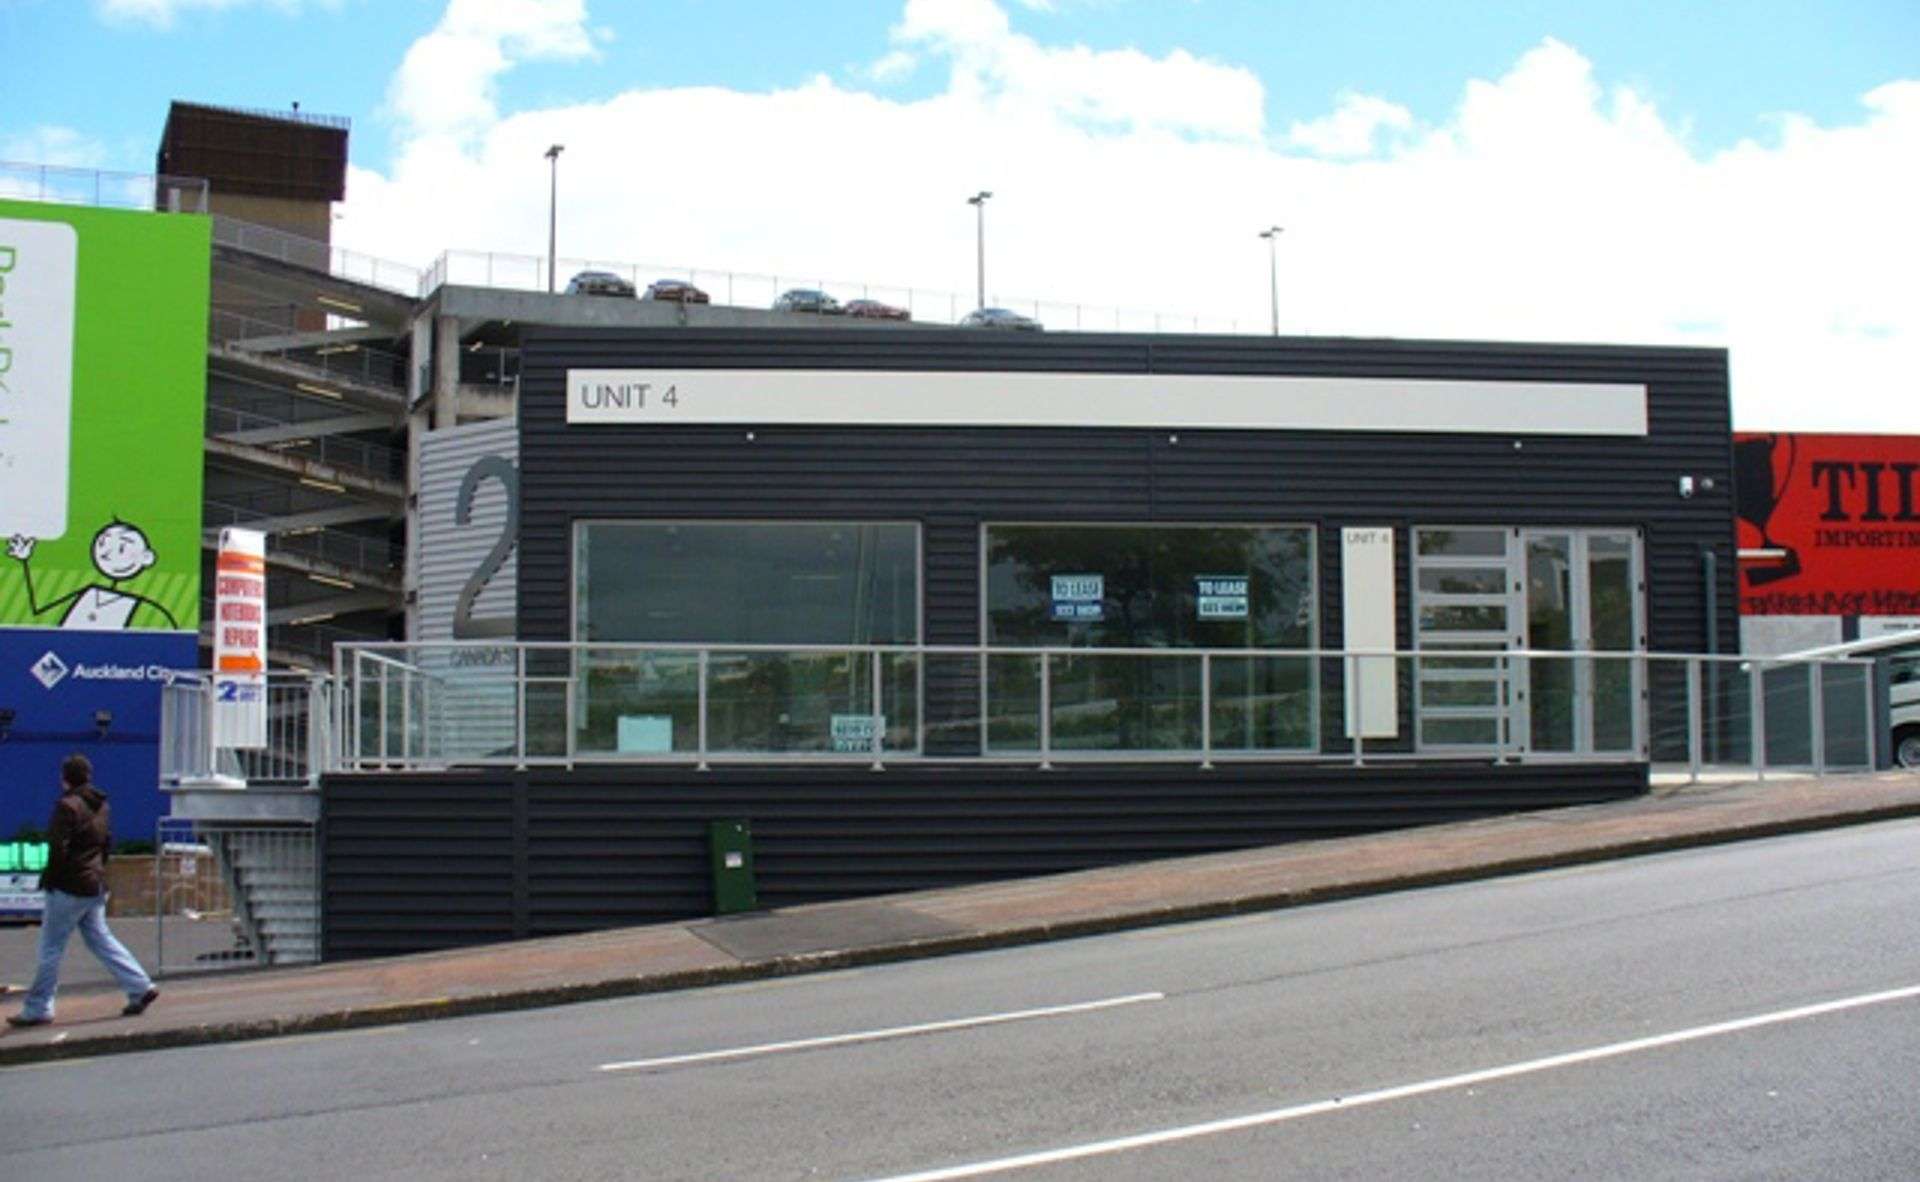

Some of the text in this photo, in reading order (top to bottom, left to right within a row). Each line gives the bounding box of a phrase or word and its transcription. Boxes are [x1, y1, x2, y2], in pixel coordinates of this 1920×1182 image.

[581, 383, 679, 409] UNIT 4
[454, 456, 519, 639] 2
[71, 662, 175, 686] Auckland City
[217, 680, 238, 702] 2
